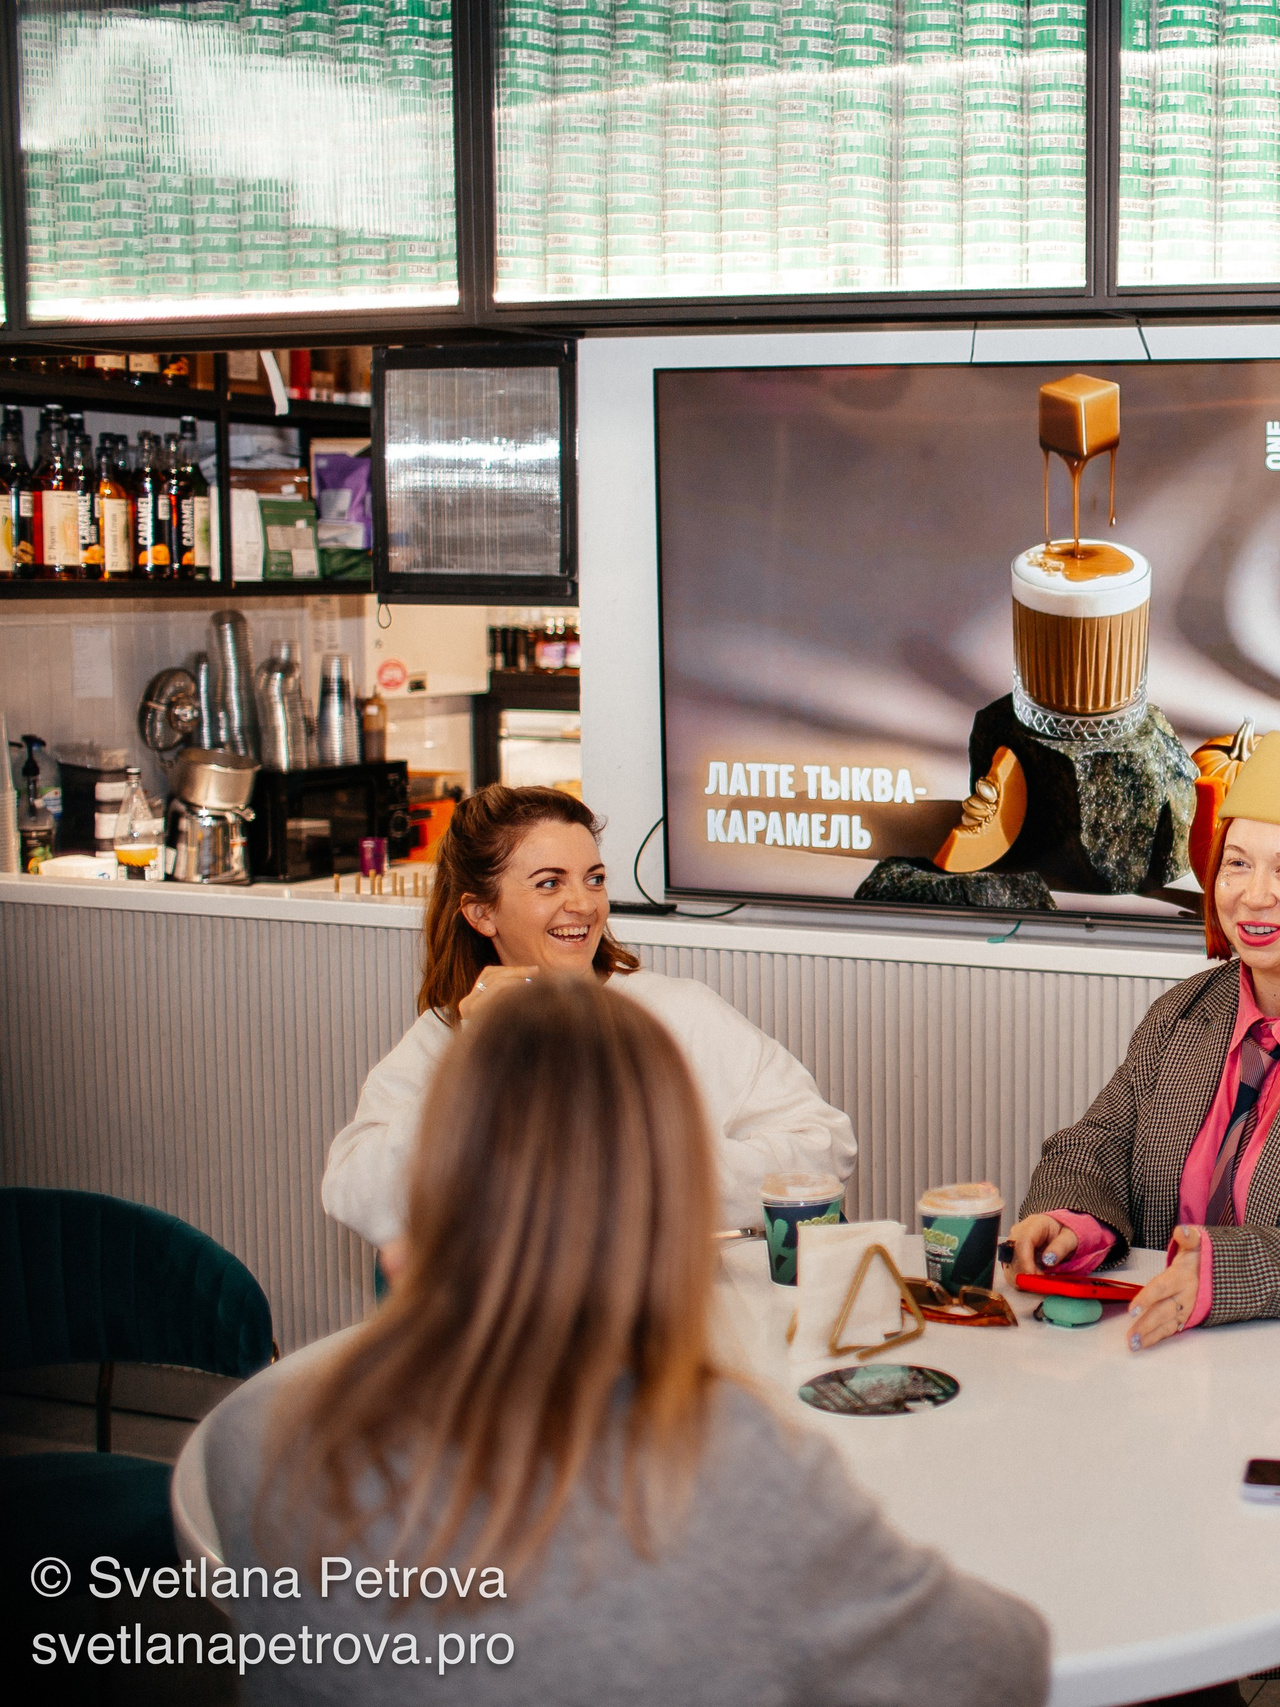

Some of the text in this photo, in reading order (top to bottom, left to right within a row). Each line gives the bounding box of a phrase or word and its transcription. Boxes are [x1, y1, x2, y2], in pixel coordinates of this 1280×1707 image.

[138, 495, 153, 546] CARAMEL
[181, 496, 194, 546] CARAMEL
[704, 761, 927, 804] ЛАТТЕ ТЫКВА-
[707, 808, 872, 851] КАРАМЕЛЬ
